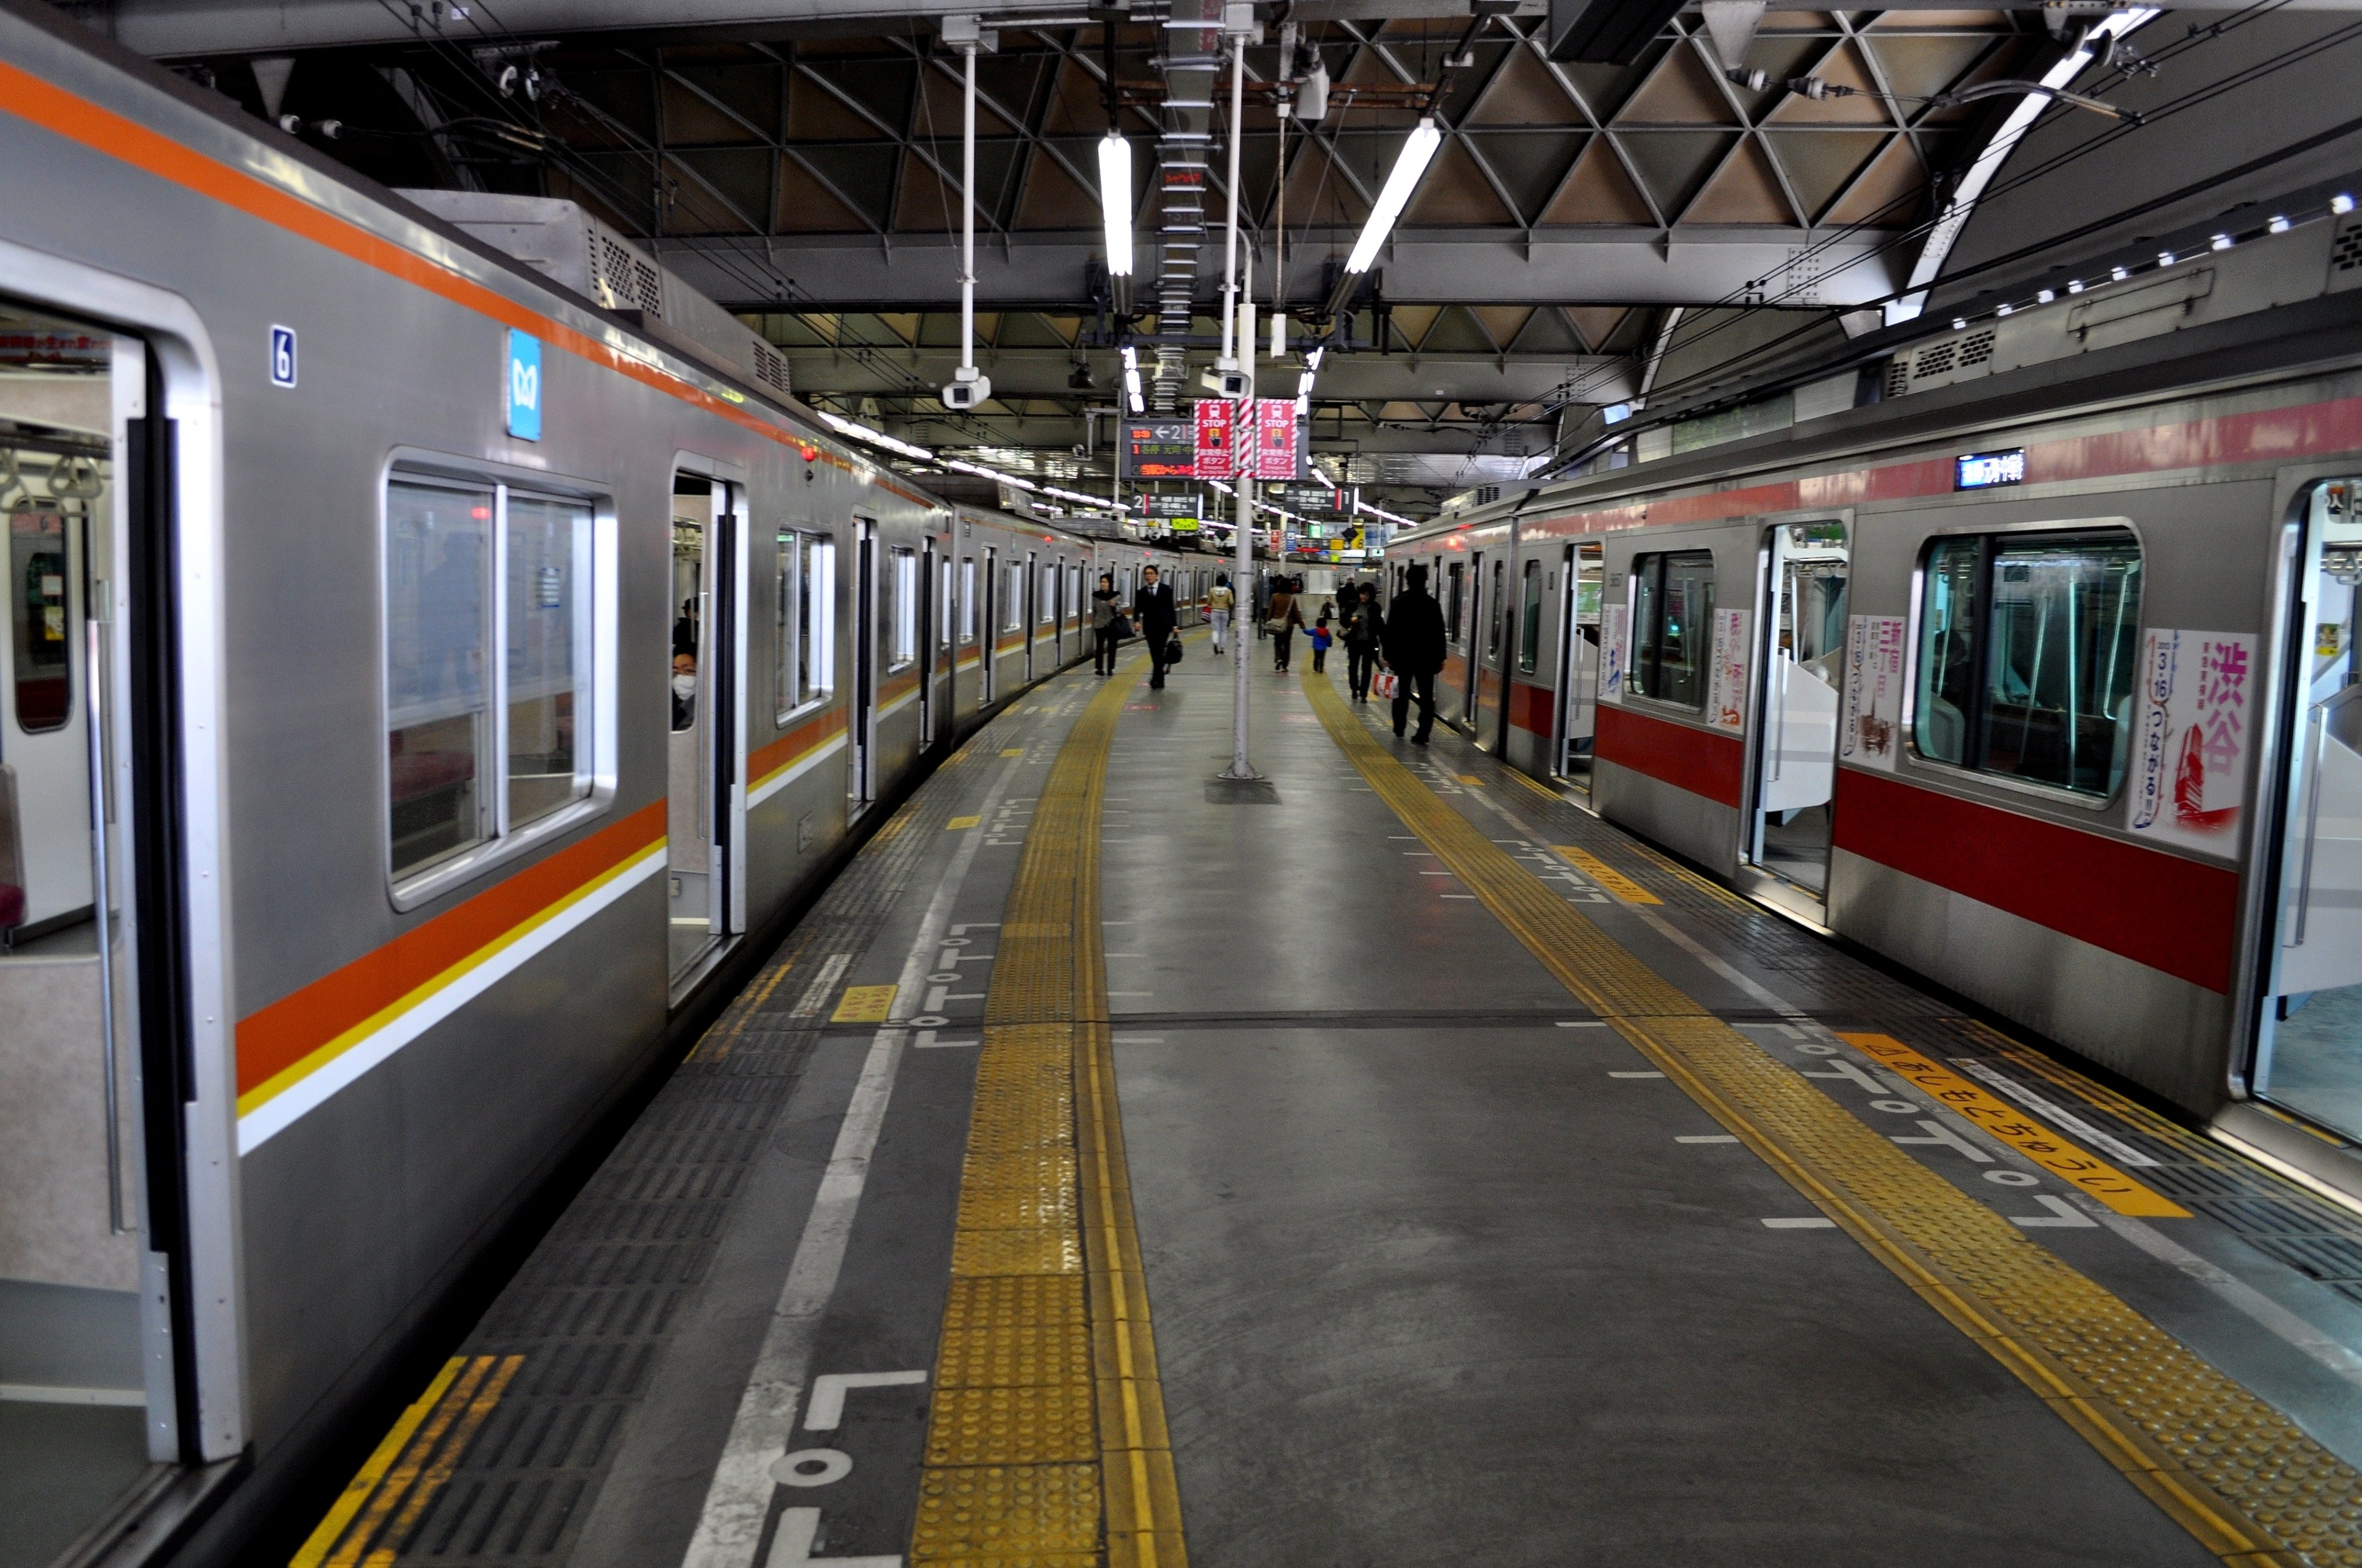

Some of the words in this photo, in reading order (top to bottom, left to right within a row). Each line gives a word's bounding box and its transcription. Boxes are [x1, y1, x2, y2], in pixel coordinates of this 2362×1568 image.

[276, 334, 289, 380] 6
[1202, 419, 1227, 428] STOP
[1264, 419, 1289, 428] STOP
[1170, 425, 1181, 439] 2
[1133, 495, 1143, 508] 2
[1343, 491, 1349, 504] 1
[2204, 642, 2248, 776] 渋谷
[1892, 1060, 2132, 1195] あしもとちゅうい
